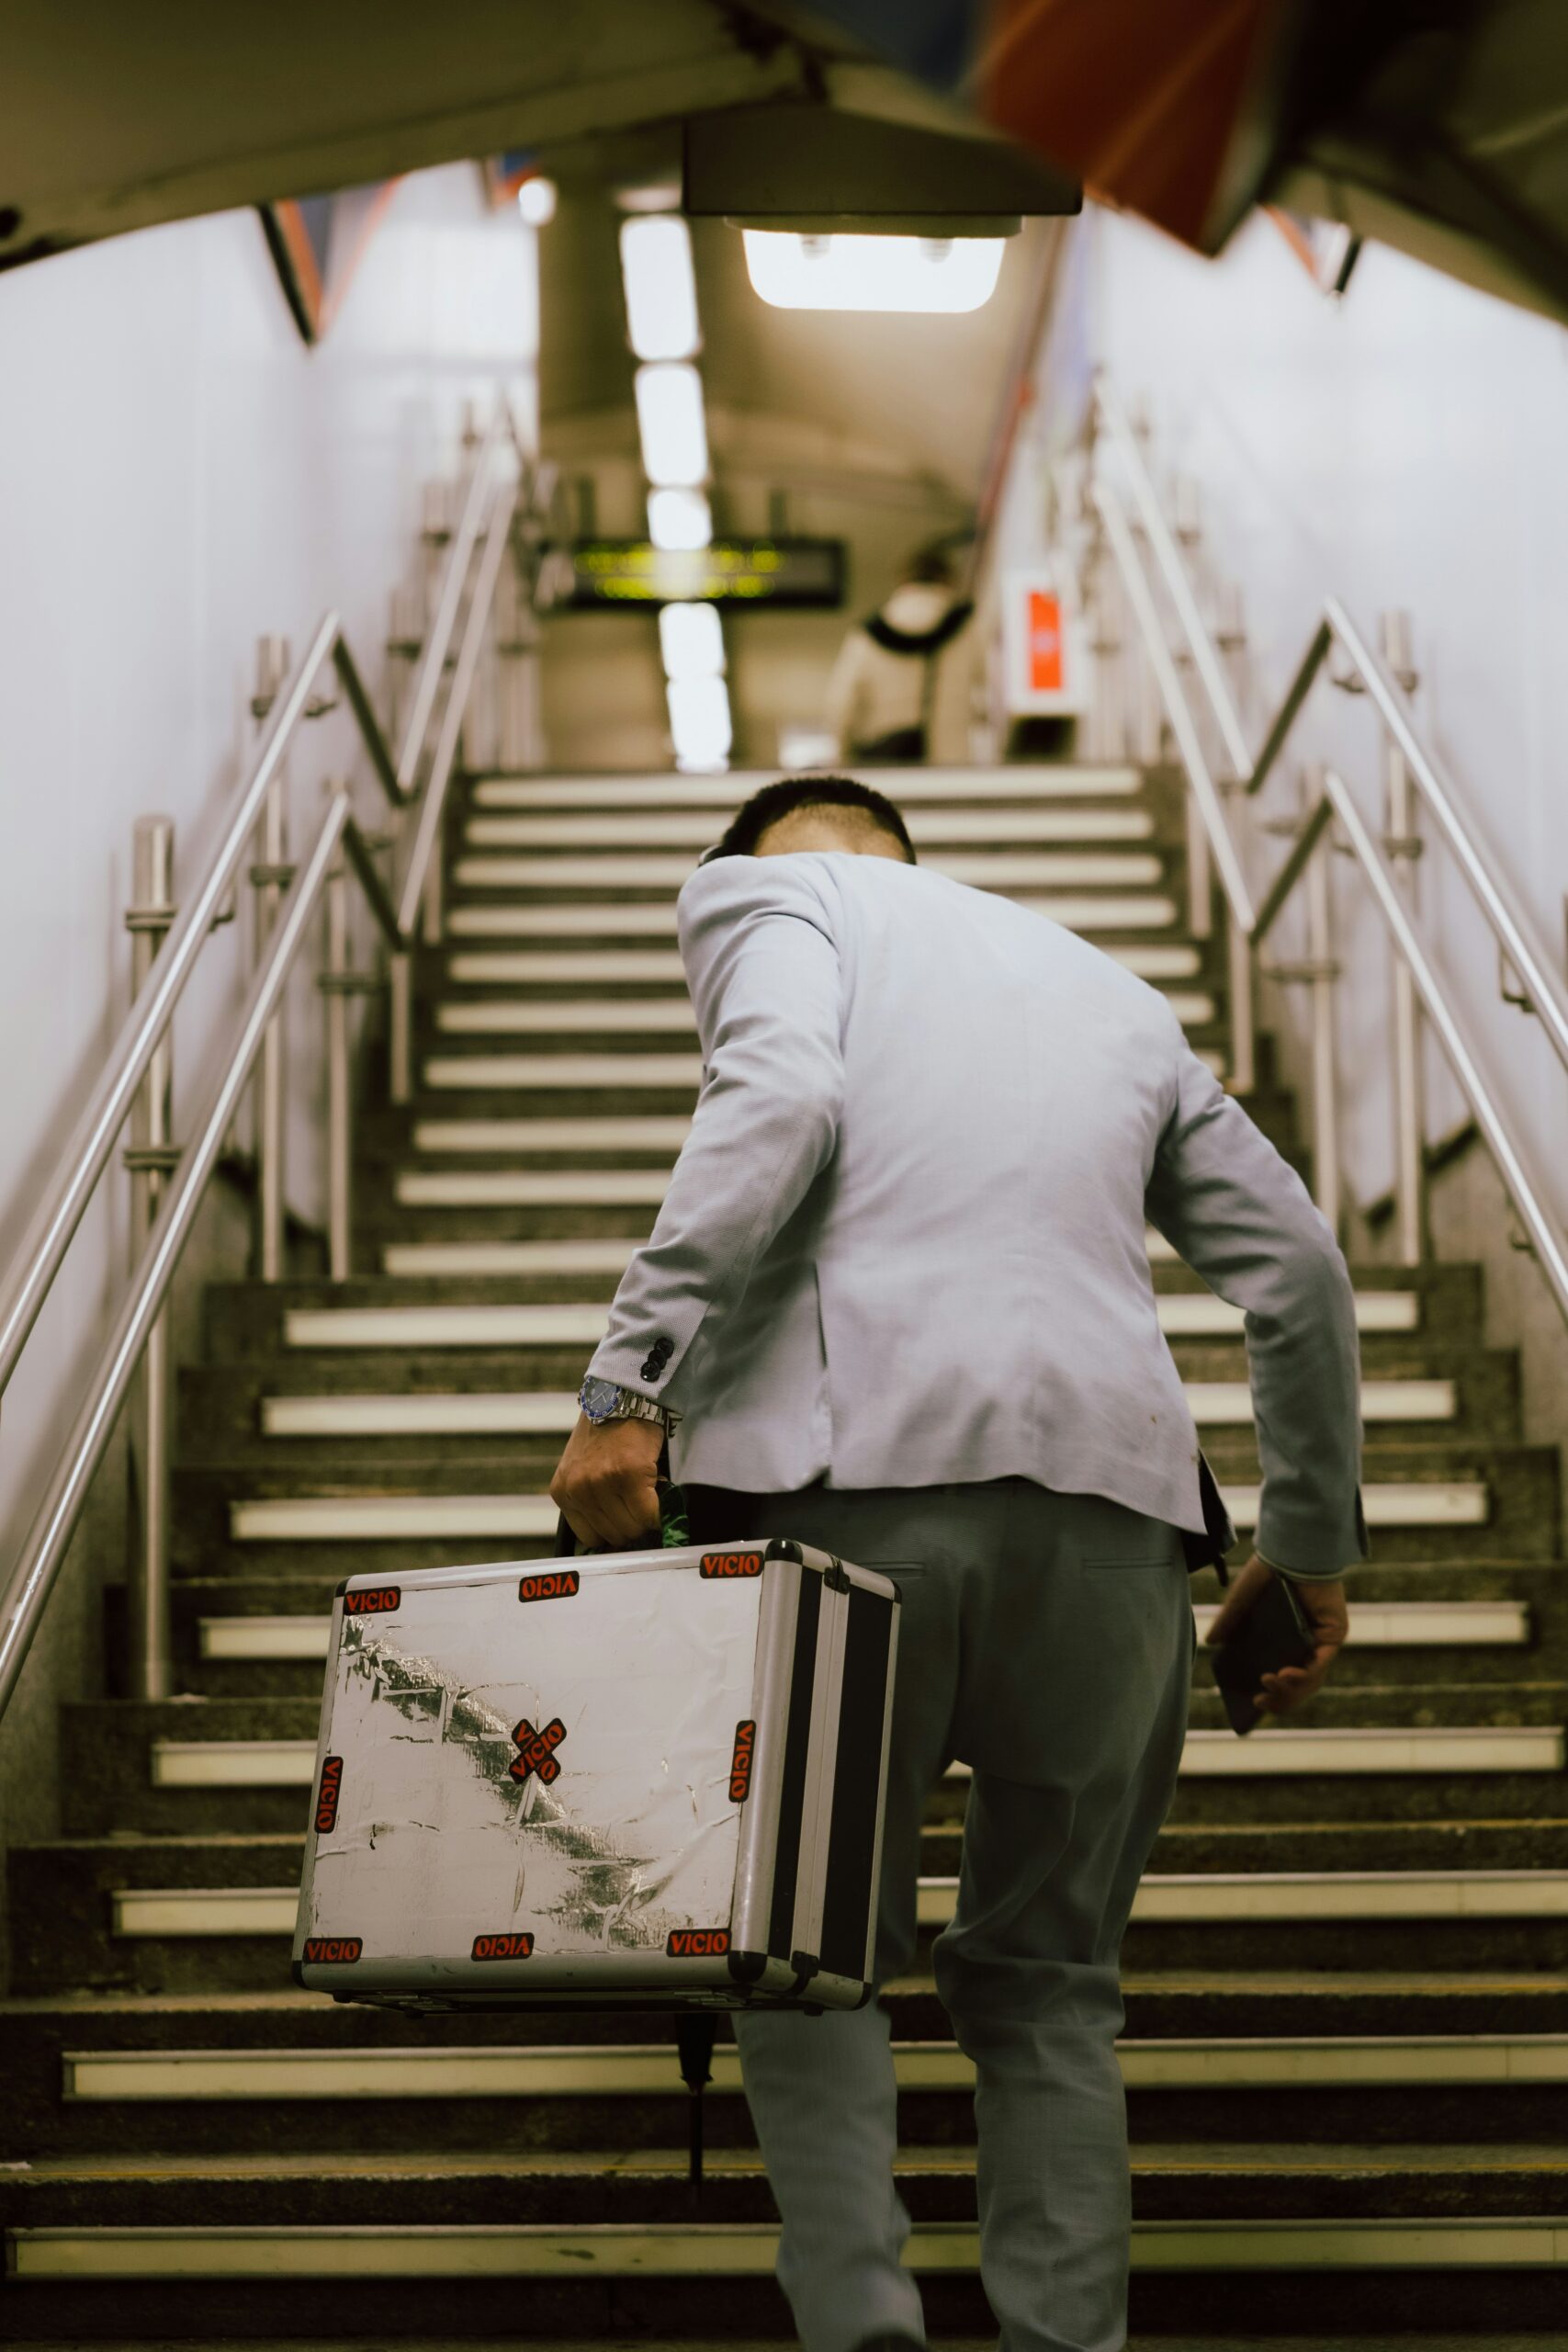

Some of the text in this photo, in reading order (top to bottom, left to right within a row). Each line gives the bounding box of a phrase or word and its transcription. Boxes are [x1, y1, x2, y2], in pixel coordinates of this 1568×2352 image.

[704, 1555, 761, 1575] VICIO
[522, 1576, 576, 1599] VICIO
[345, 1590, 398, 1611] VICIO
[511, 1724, 562, 1778] VICIO
[732, 1724, 752, 1797] VICIO
[319, 1762, 340, 1828] VICIO
[309, 1942, 358, 1960] VICIO
[476, 1938, 530, 1957] VICIO
[671, 1932, 728, 1953] VICIO
